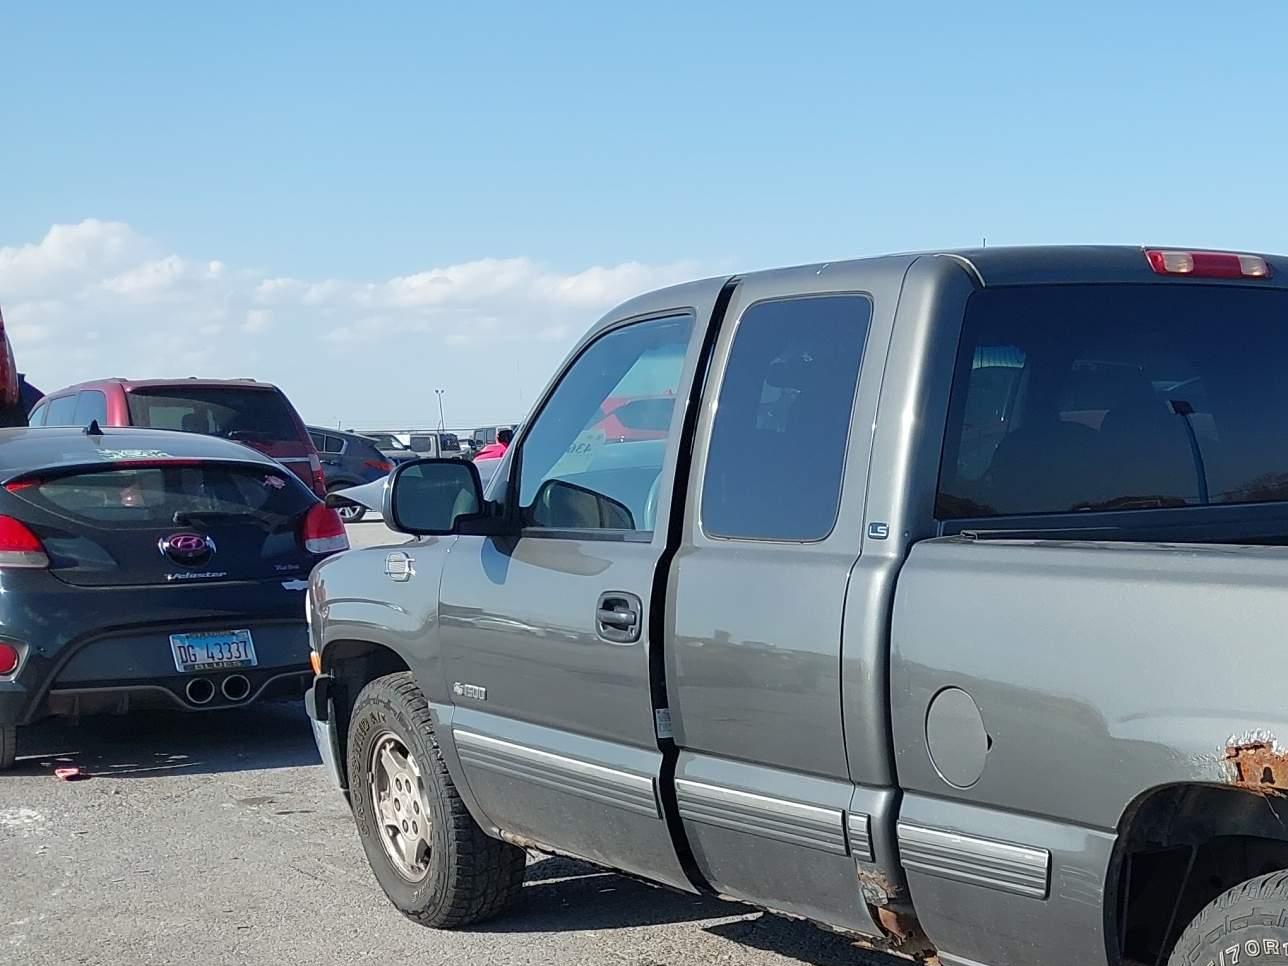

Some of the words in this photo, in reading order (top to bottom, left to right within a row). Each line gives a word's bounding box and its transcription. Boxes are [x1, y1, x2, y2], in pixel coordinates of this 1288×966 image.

[869, 525, 888, 537] LS
[165, 571, 228, 581] Veloster
[177, 645, 198, 664] DG
[206, 641, 250, 661] 43337
